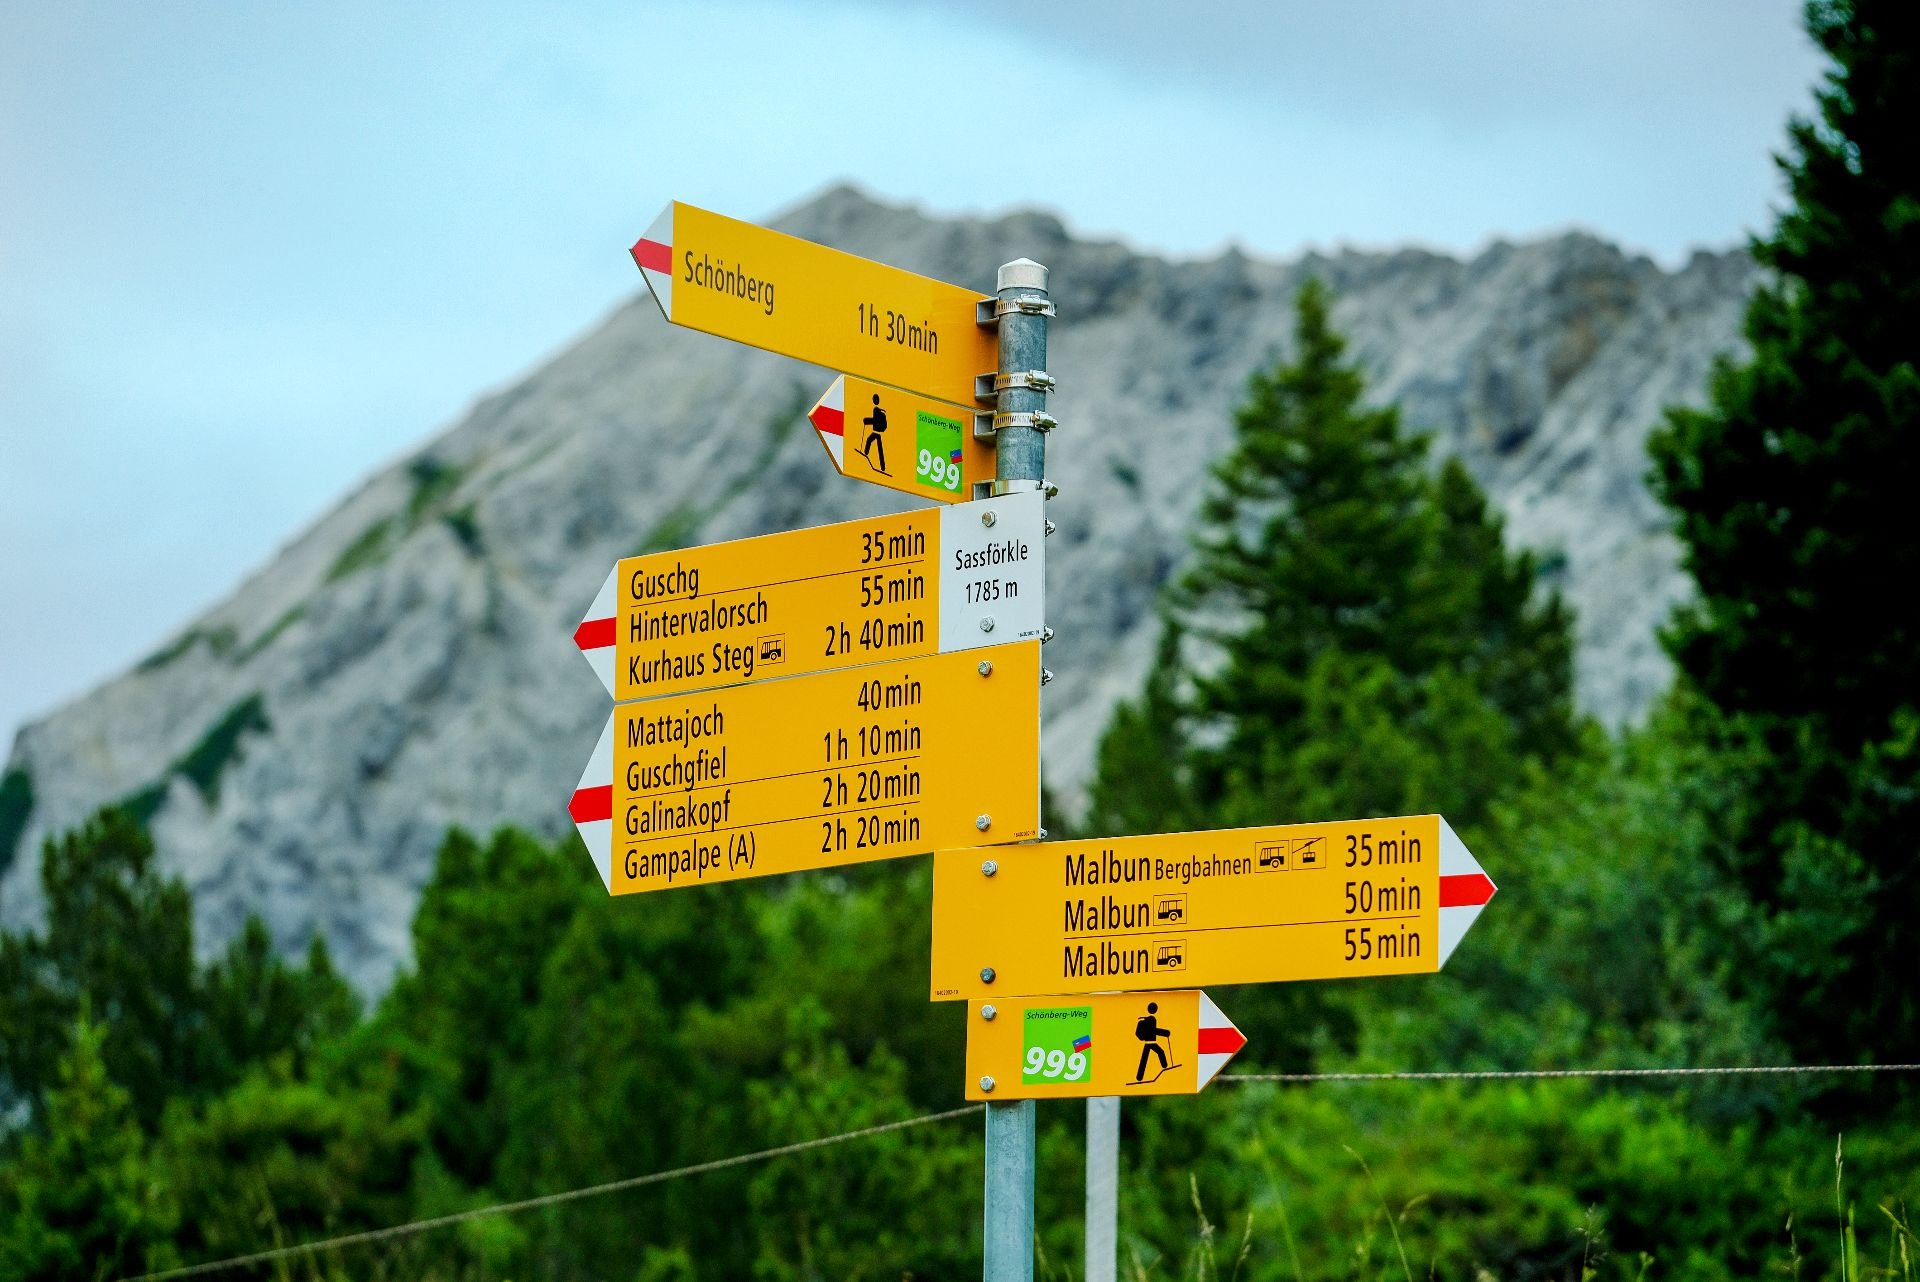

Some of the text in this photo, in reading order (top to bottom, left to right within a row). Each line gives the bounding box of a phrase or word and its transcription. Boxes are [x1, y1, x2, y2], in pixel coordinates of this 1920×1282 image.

[684, 250, 774, 316] Schönberg
[916, 448, 960, 490] 999
[955, 538, 1028, 571] Sassförkle
[630, 560, 700, 600] Guschg
[965, 578, 1018, 604] 1785 m
[630, 591, 768, 643] Hintervalorsch
[629, 649, 705, 686] Kurhaus
[712, 642, 754, 678] Steg
[627, 703, 724, 749] Mattajoch
[626, 746, 727, 793] Guschgfiel
[625, 789, 731, 836] Galinakopf
[624, 841, 721, 883] Gampalpe
[728, 832, 756, 872] (A)
[1064, 850, 1151, 887] Malbun
[1154, 853, 1251, 885] Bergbahnen
[1064, 897, 1151, 933] Malbun
[1063, 941, 1149, 978] Malbun
[1022, 1046, 1087, 1081] 999
